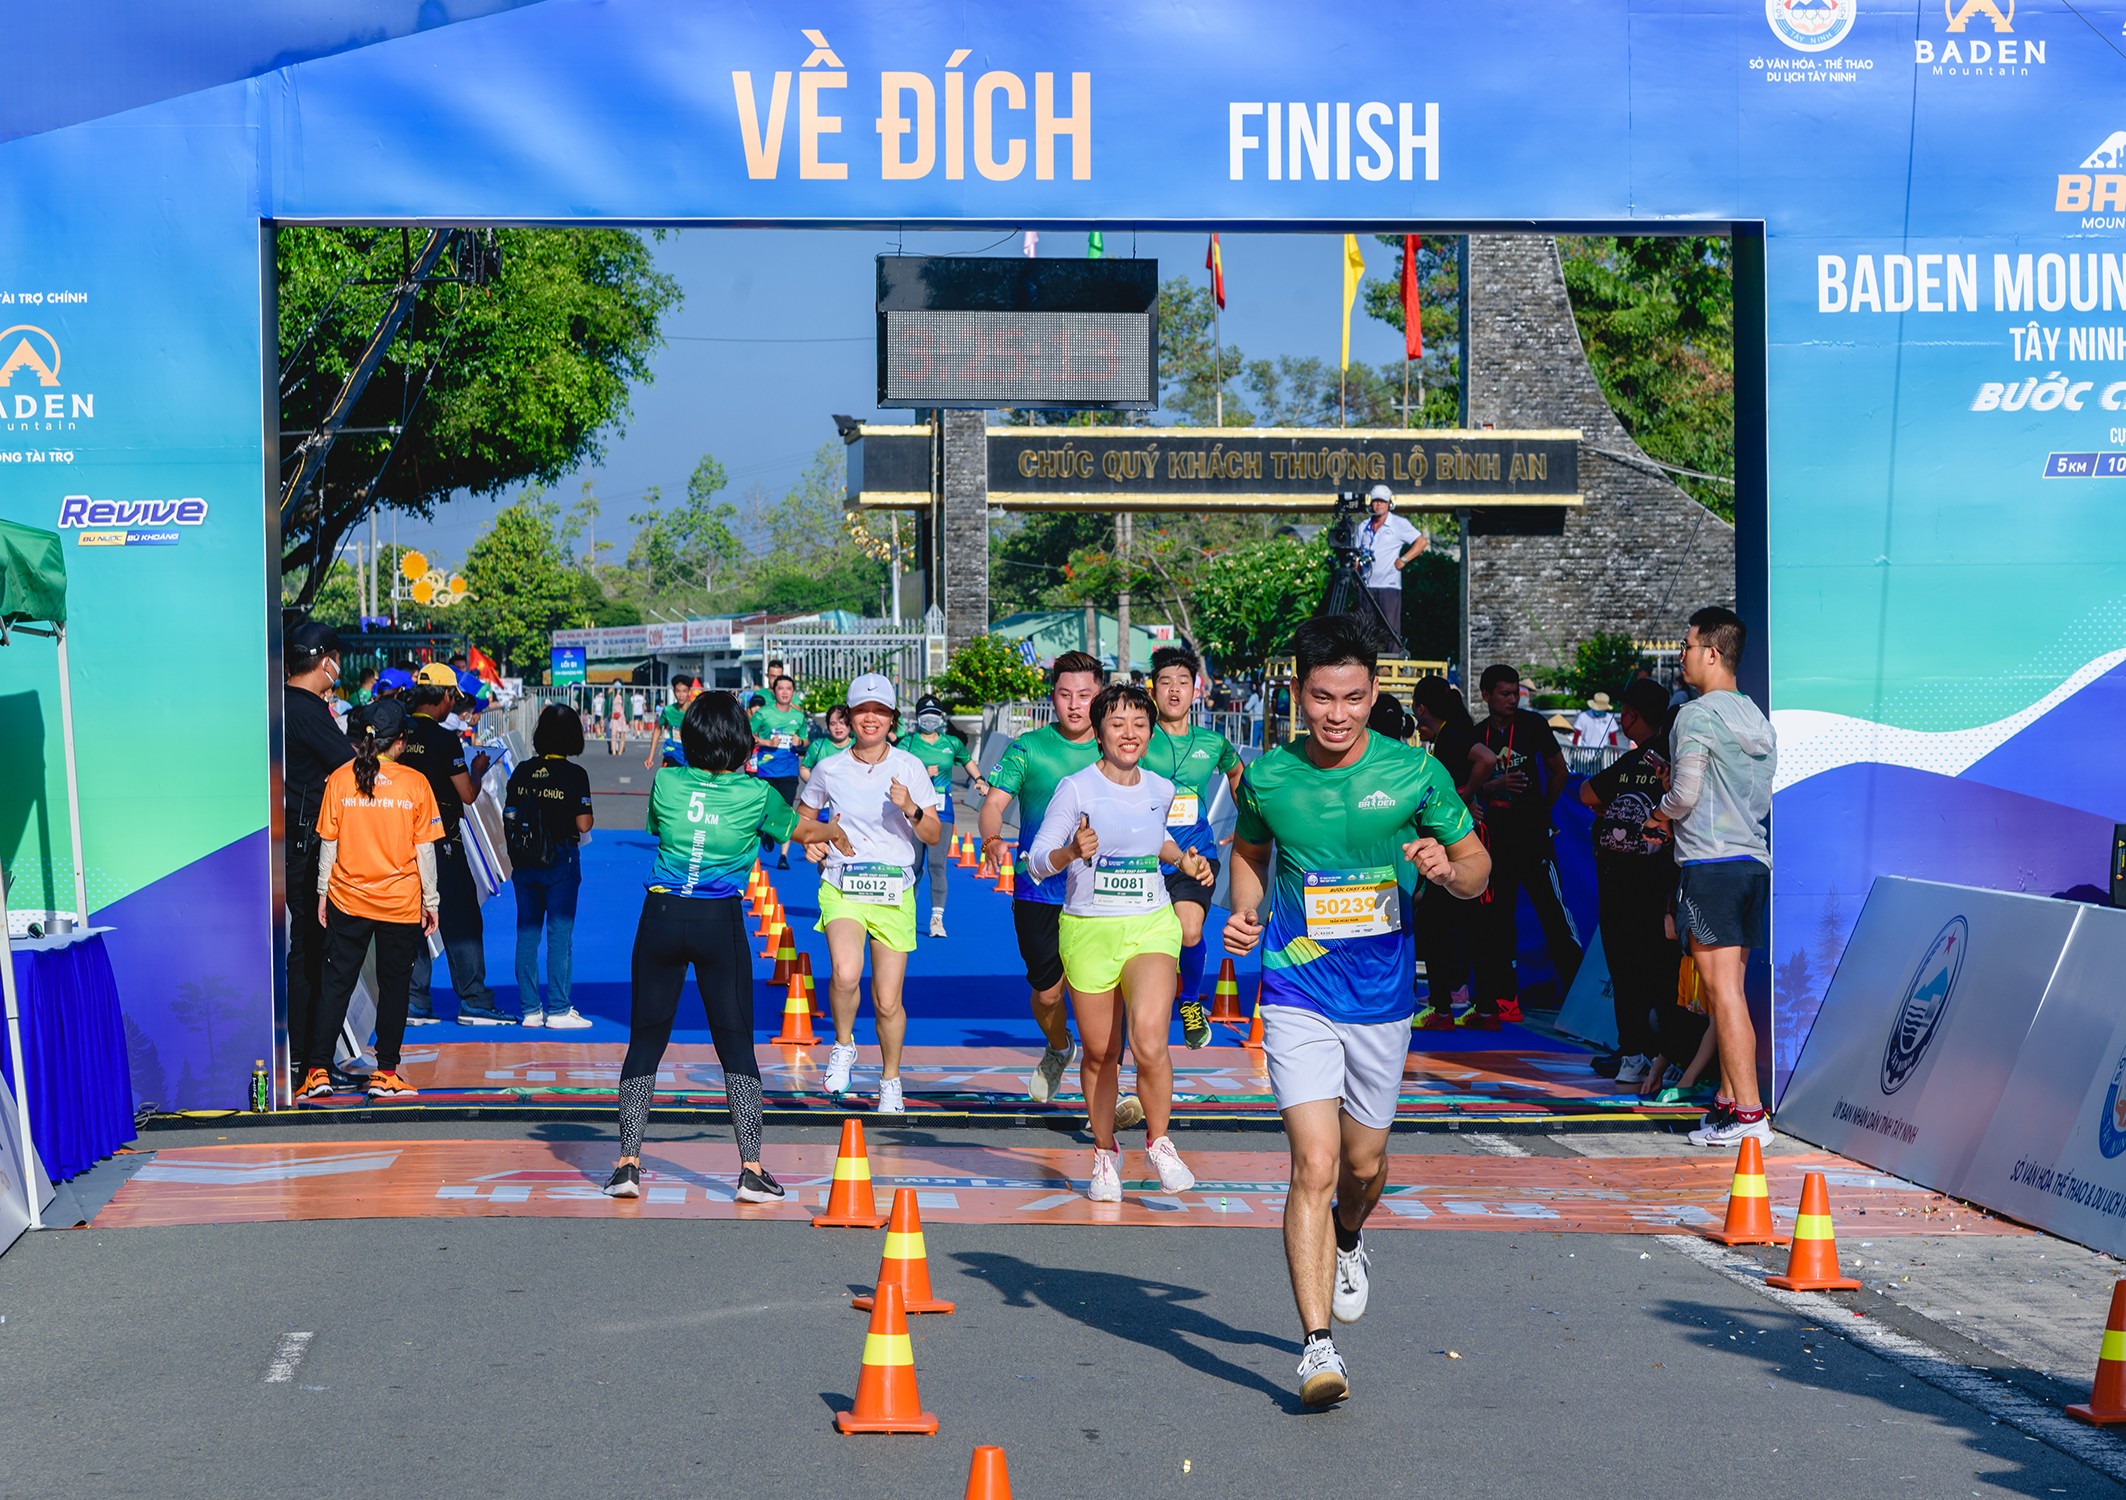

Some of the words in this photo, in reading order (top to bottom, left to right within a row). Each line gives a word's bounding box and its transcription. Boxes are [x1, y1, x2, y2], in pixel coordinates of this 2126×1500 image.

[1915, 40, 2046, 64] BADEN
[1766, 57, 1789, 69] VĂN
[1791, 56, 1816, 70] HÓA
[1824, 56, 1843, 70] THỂ
[1845, 59, 1874, 70] THAO
[1932, 65, 2029, 77] Mountain
[1766, 72, 1781, 82] DU
[1784, 72, 1805, 84] LỊCH
[1808, 71, 1826, 82] TÂY
[1829, 72, 1857, 82] NINH
[731, 28, 849, 181] VỀ
[876, 48, 1092, 181] ĐÍCH
[1228, 101, 1440, 182] FINISH
[2081, 217, 2125, 229] MOUN
[1817, 254, 1978, 313] BADEN
[18, 291, 44, 306] TRỢ
[46, 290, 88, 304] CHÍNH
[2009, 320, 2061, 362] TÂY
[1969, 371, 2094, 412] BƯỚC
[0, 421, 76, 431] untain
[0, 451, 22, 463] NG
[25, 449, 45, 463] TÀI
[49, 450, 74, 464] TRỢ
[1017, 442, 1094, 478] CHÚC
[1102, 441, 1157, 483] QUÝ
[1167, 443, 1263, 480] KHÁCH
[1269, 446, 1385, 486] THƯỢNG
[1392, 445, 1427, 487] LỘ
[1435, 445, 1501, 481] BÌNH
[1508, 452, 1547, 481] AN
[59, 496, 207, 527] Revive
[849, 879, 887, 891] 10612
[1103, 876, 1144, 889] 10081
[1315, 896, 1376, 915] 50239
[2064, 1177, 2090, 1204] THAO
[2091, 1186, 2108, 1210] DU
